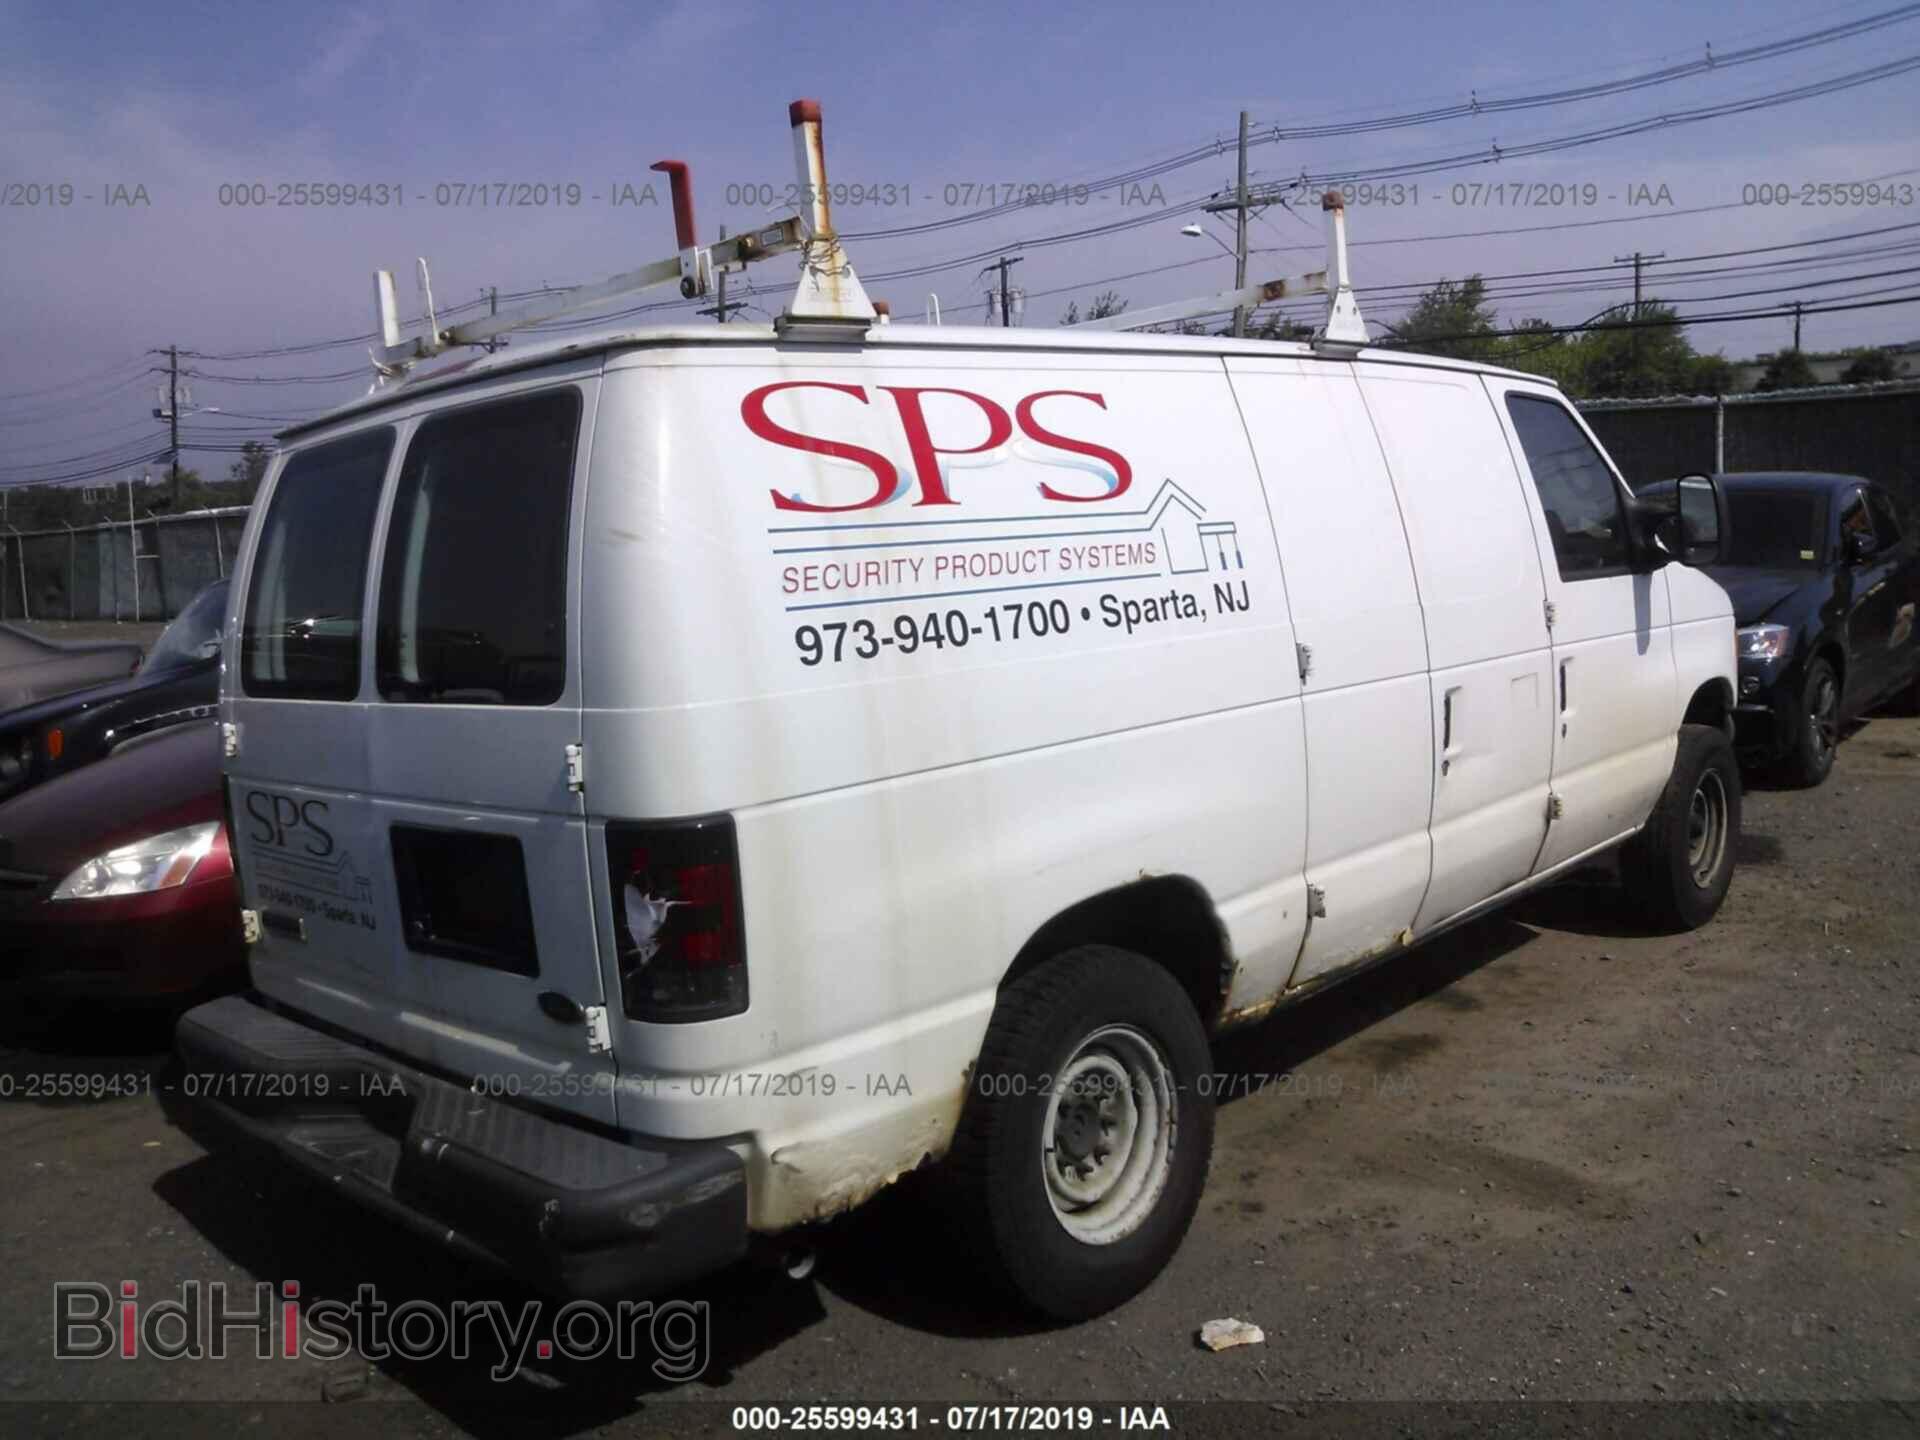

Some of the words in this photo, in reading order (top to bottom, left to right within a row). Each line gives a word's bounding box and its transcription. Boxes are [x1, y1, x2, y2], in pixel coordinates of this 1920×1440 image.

[740, 381, 1132, 512] SPS
[782, 557, 924, 593] SECURITY
[935, 549, 1050, 580] PRODUCT
[1058, 542, 1157, 571] SYSTEMS
[794, 599, 1070, 666] 973-940-1700
[1100, 589, 1207, 634] Sparta,
[1213, 580, 1251, 614] NJ
[246, 791, 334, 856] SPS
